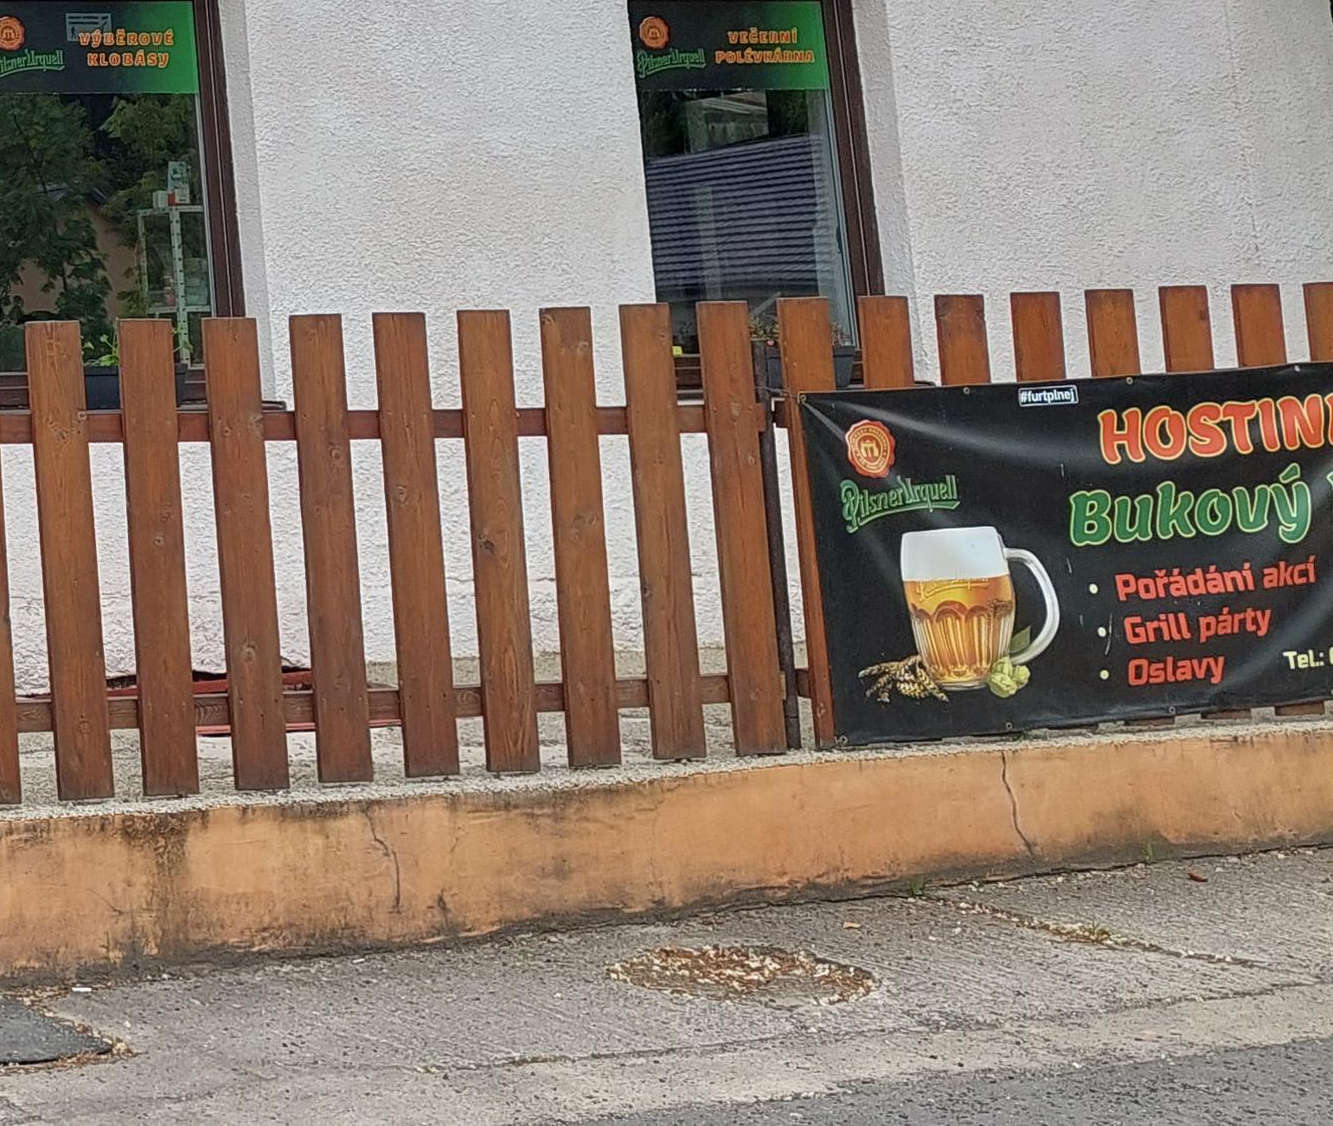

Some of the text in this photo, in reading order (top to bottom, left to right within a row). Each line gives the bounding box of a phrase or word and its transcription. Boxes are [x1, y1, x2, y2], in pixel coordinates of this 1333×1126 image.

[78, 28, 174, 49] VÝBĚROVÉ
[727, 27, 798, 45] VEČERNÍ
[24, 48, 65, 72] Urquell
[86, 49, 170, 68] KLOBÁSY
[714, 46, 816, 64] POLÉVKÁRNA
[1019, 388, 1075, 404] #furtplnej
[1098, 393, 1333, 465] HOSTIN
[839, 474, 959, 534] Pilsner Urquell
[1069, 462, 1312, 547] Bukový
[1115, 555, 1317, 601] Pořádání akcí
[1123, 607, 1271, 645] Grill párty
[1128, 656, 1225, 686] Oslavy
